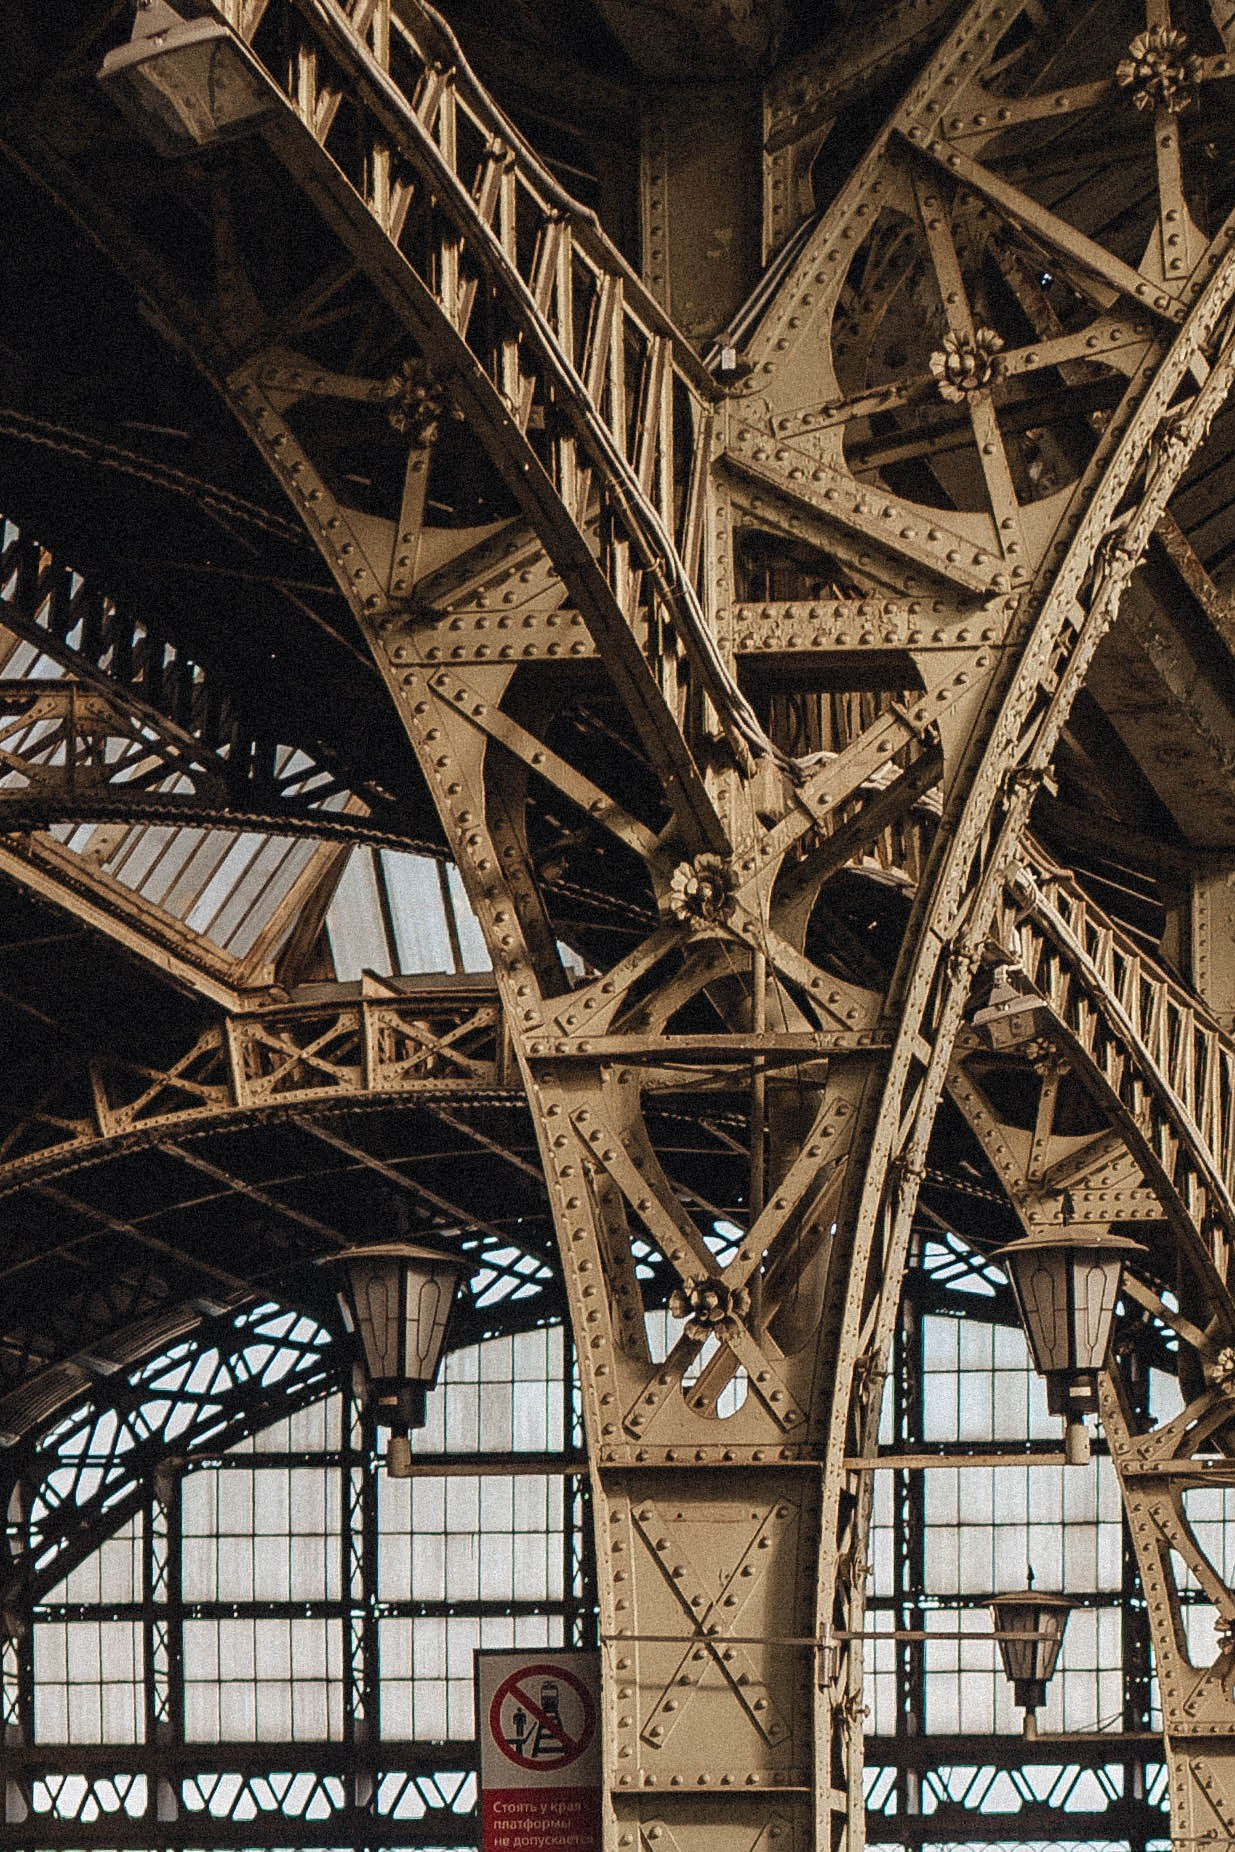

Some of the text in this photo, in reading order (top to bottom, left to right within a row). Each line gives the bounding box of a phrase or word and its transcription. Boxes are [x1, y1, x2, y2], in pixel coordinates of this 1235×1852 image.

[493, 1801, 582, 1815] Стоять у края
[493, 1818, 571, 1831] платформы
[494, 1835, 594, 1848] не допускается
